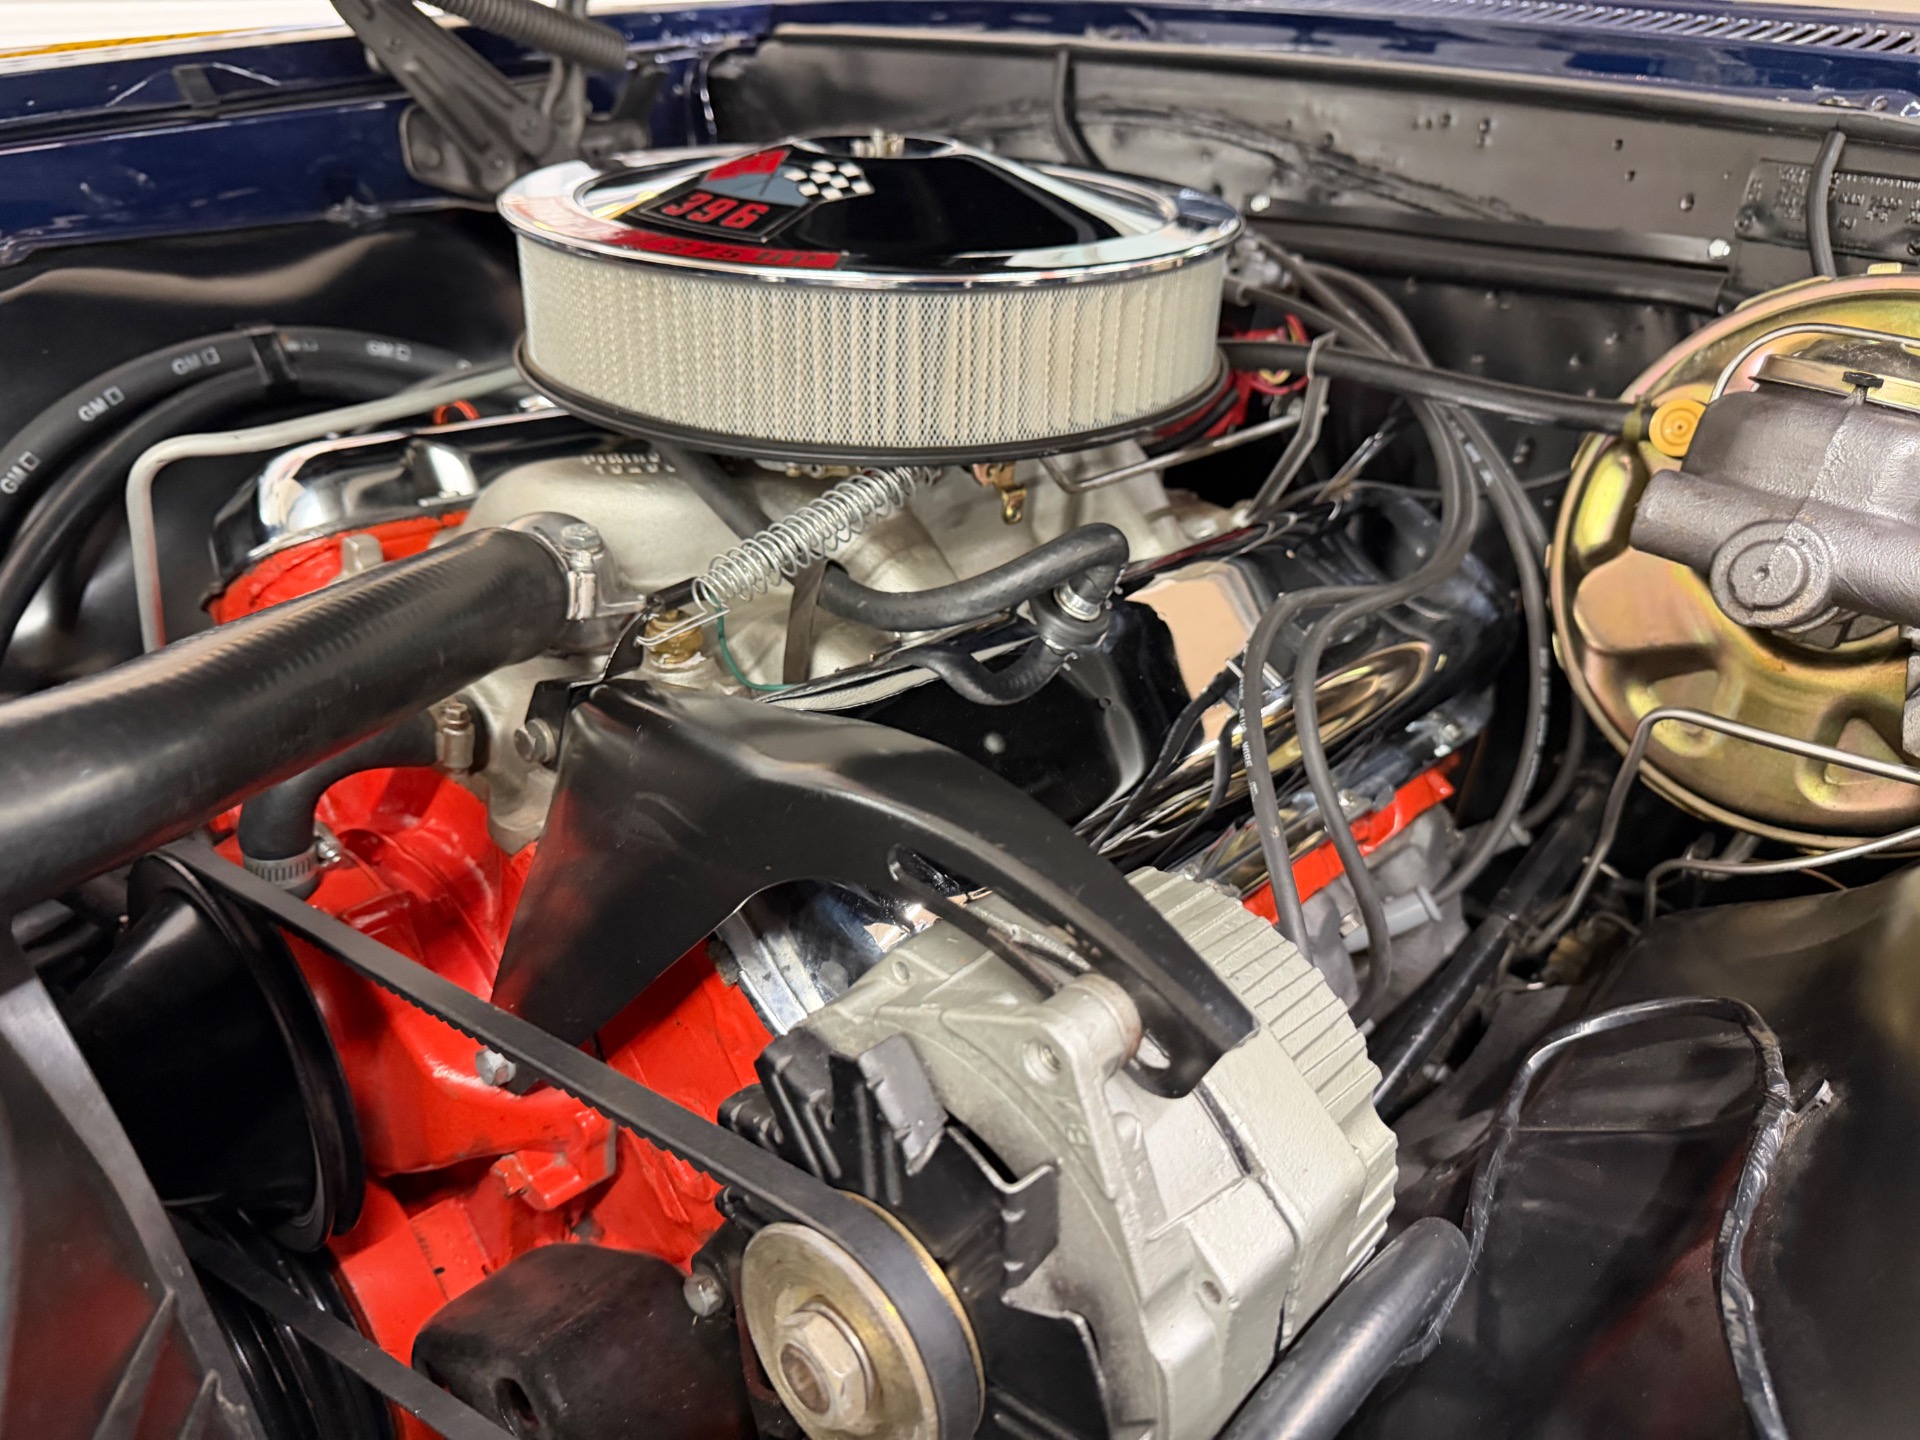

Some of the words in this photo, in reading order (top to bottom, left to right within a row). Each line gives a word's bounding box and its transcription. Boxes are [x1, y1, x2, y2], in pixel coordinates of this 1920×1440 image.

[661, 193, 769, 229] 396
[171, 353, 201, 375] GM
[78, 397, 109, 422] GM
[0, 465, 28, 494] GM
[1242, 741, 1254, 768] WIRE
